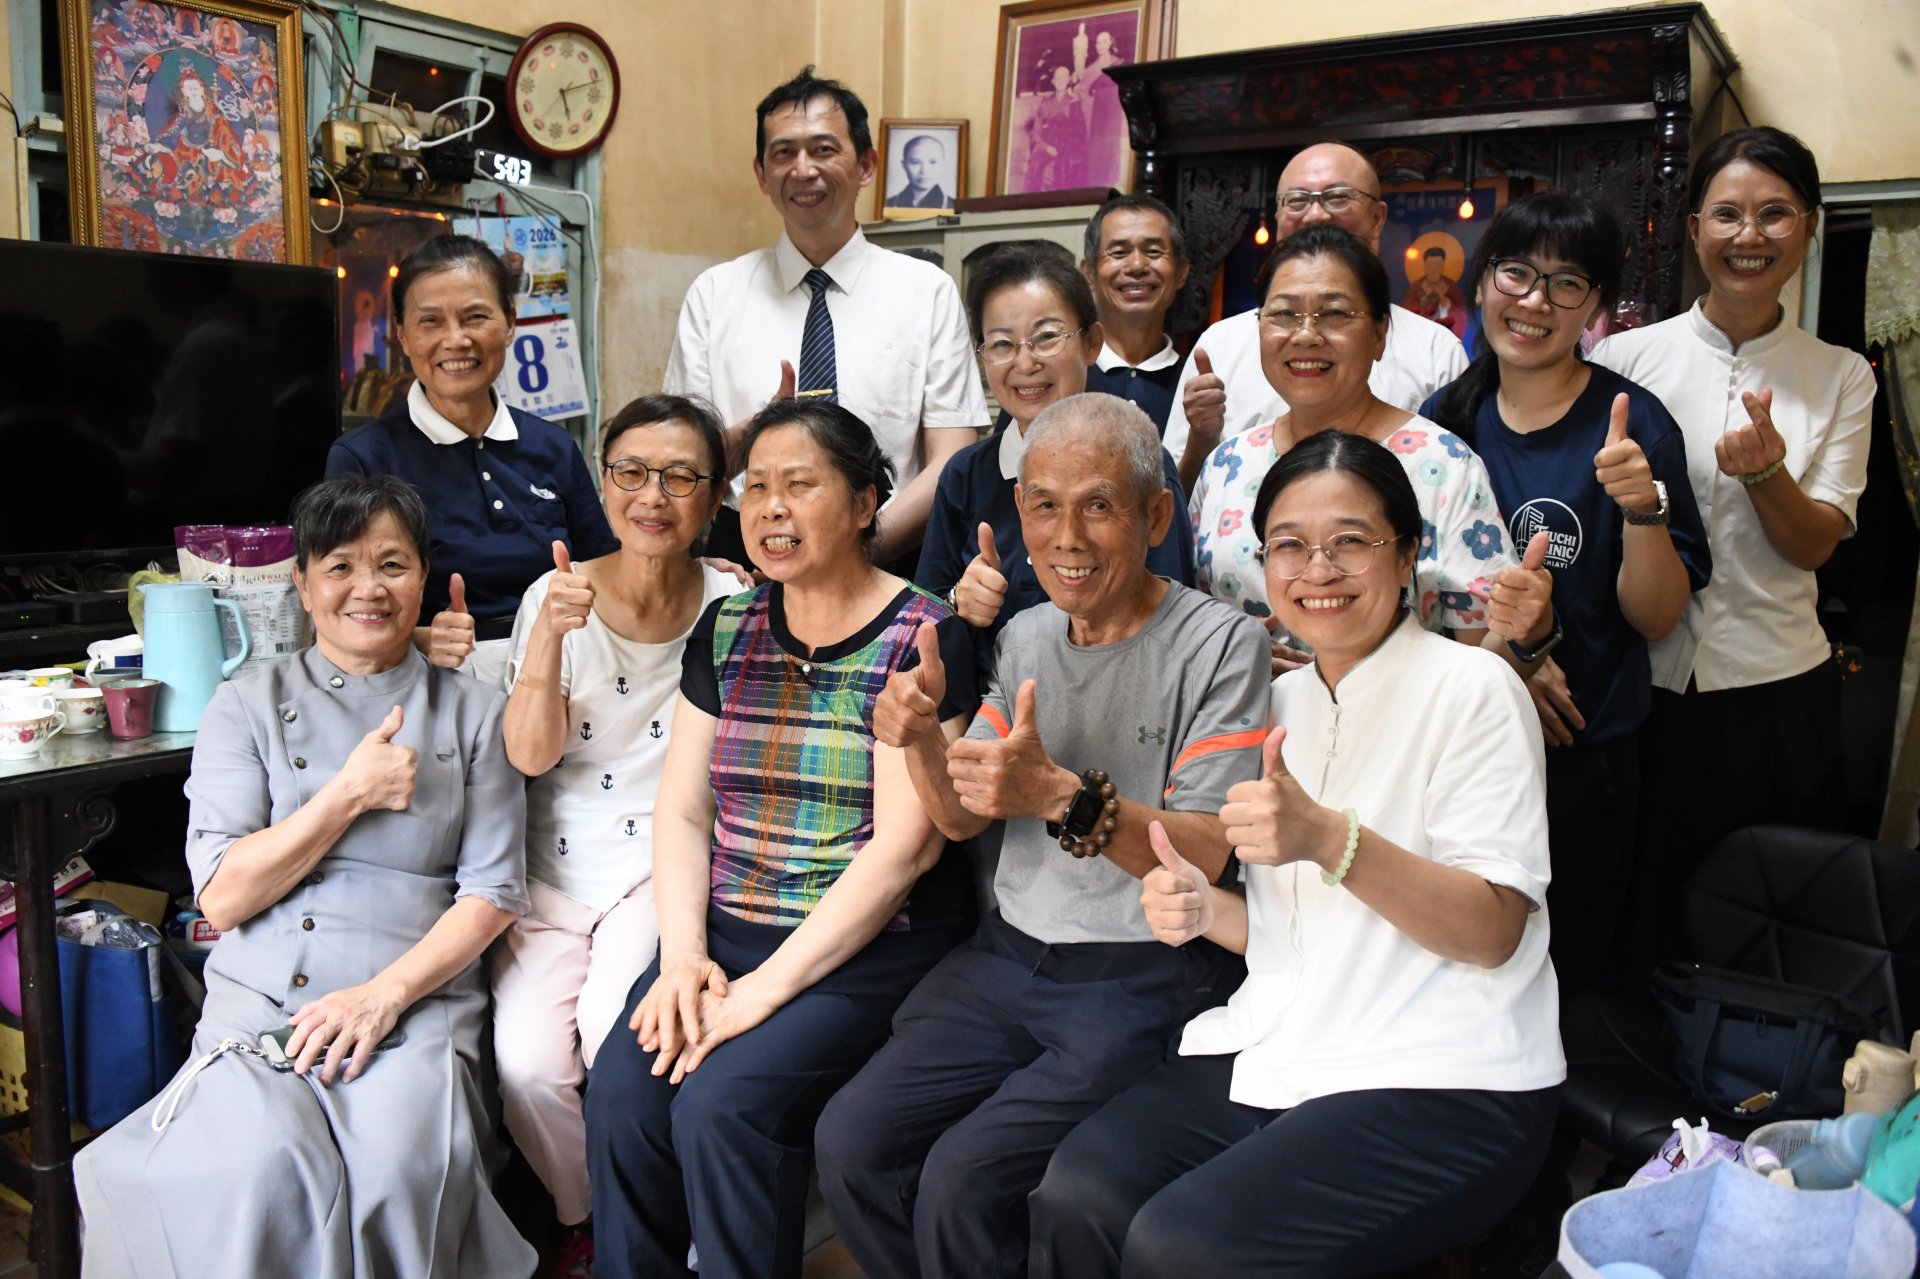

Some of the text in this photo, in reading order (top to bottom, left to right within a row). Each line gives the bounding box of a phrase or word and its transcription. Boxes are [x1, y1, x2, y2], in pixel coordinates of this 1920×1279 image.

[529, 228, 557, 242] 2026
[513, 334, 549, 394] 8
[1534, 524, 1577, 547] TUCHI
[1545, 543, 1574, 560] INIC
